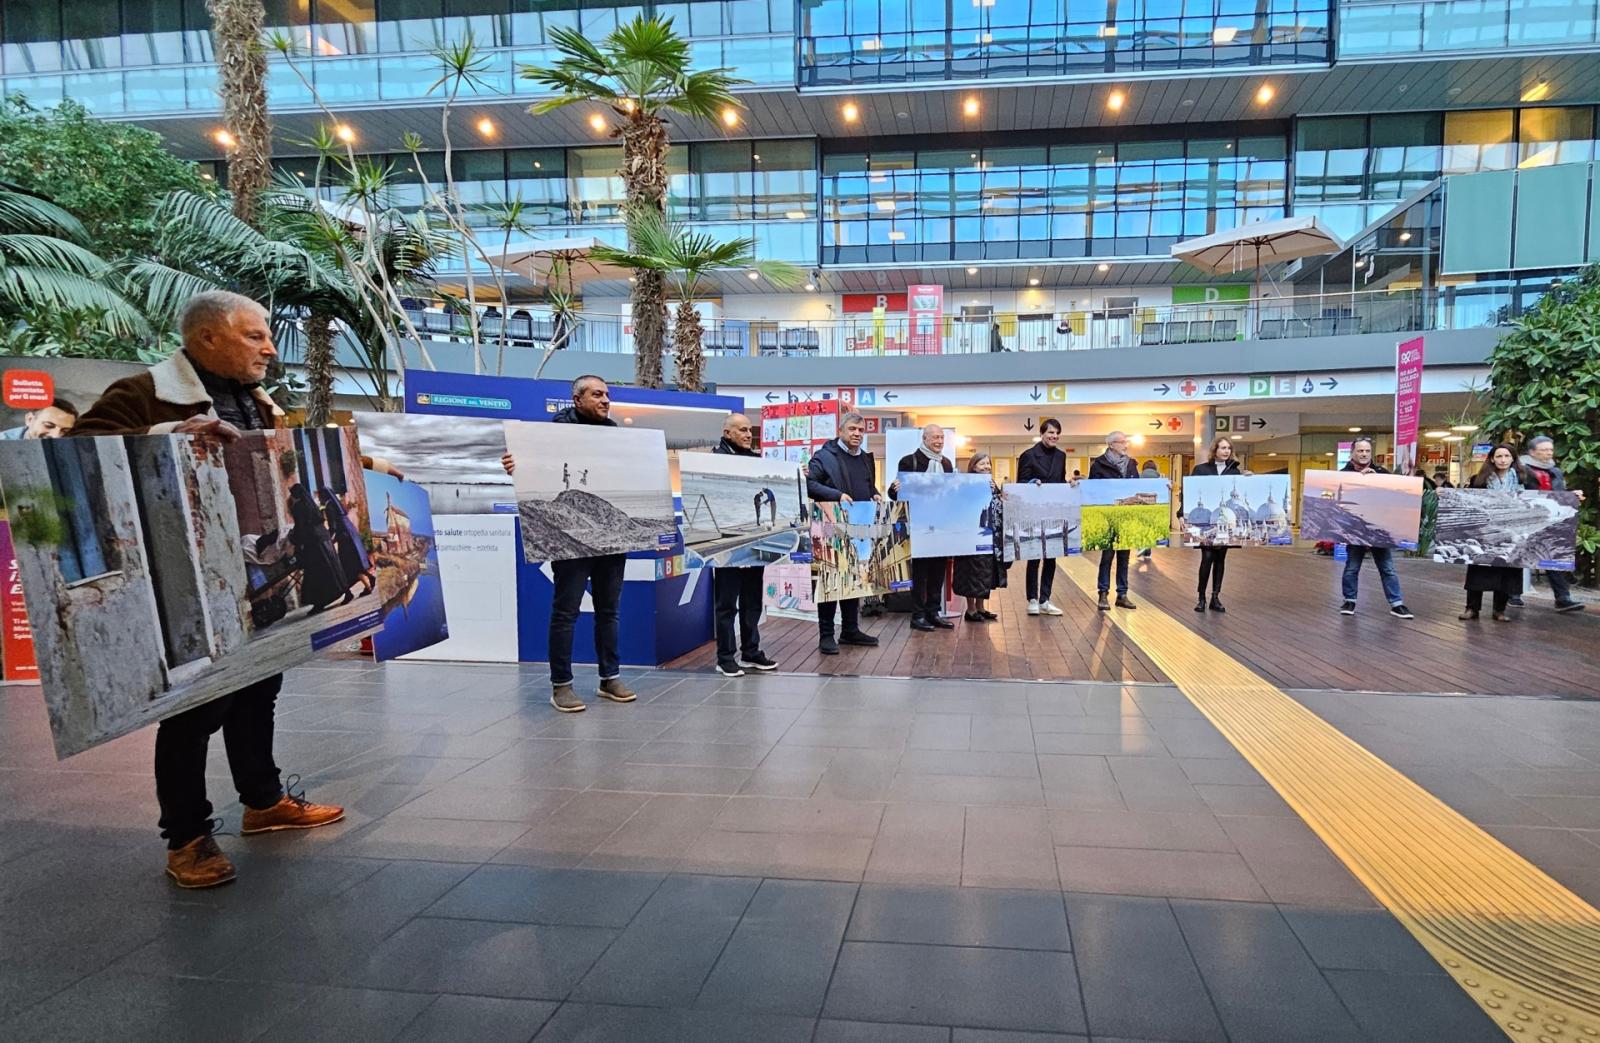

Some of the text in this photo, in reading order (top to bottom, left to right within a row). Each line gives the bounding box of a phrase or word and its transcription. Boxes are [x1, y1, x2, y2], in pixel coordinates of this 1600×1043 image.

[877, 294, 888, 309] B
[1205, 288, 1219, 303] D
[1218, 382, 1236, 392] CUP
[1254, 379, 1291, 393] D E
[841, 390, 873, 404] B A
[1052, 387, 1061, 399] C
[434, 396, 468, 405] REGIONE
[866, 420, 876, 431] B
[1217, 418, 1246, 430] D E
[444, 527, 462, 537] salute
[656, 562, 663, 577] A
[666, 560, 672, 574] B
